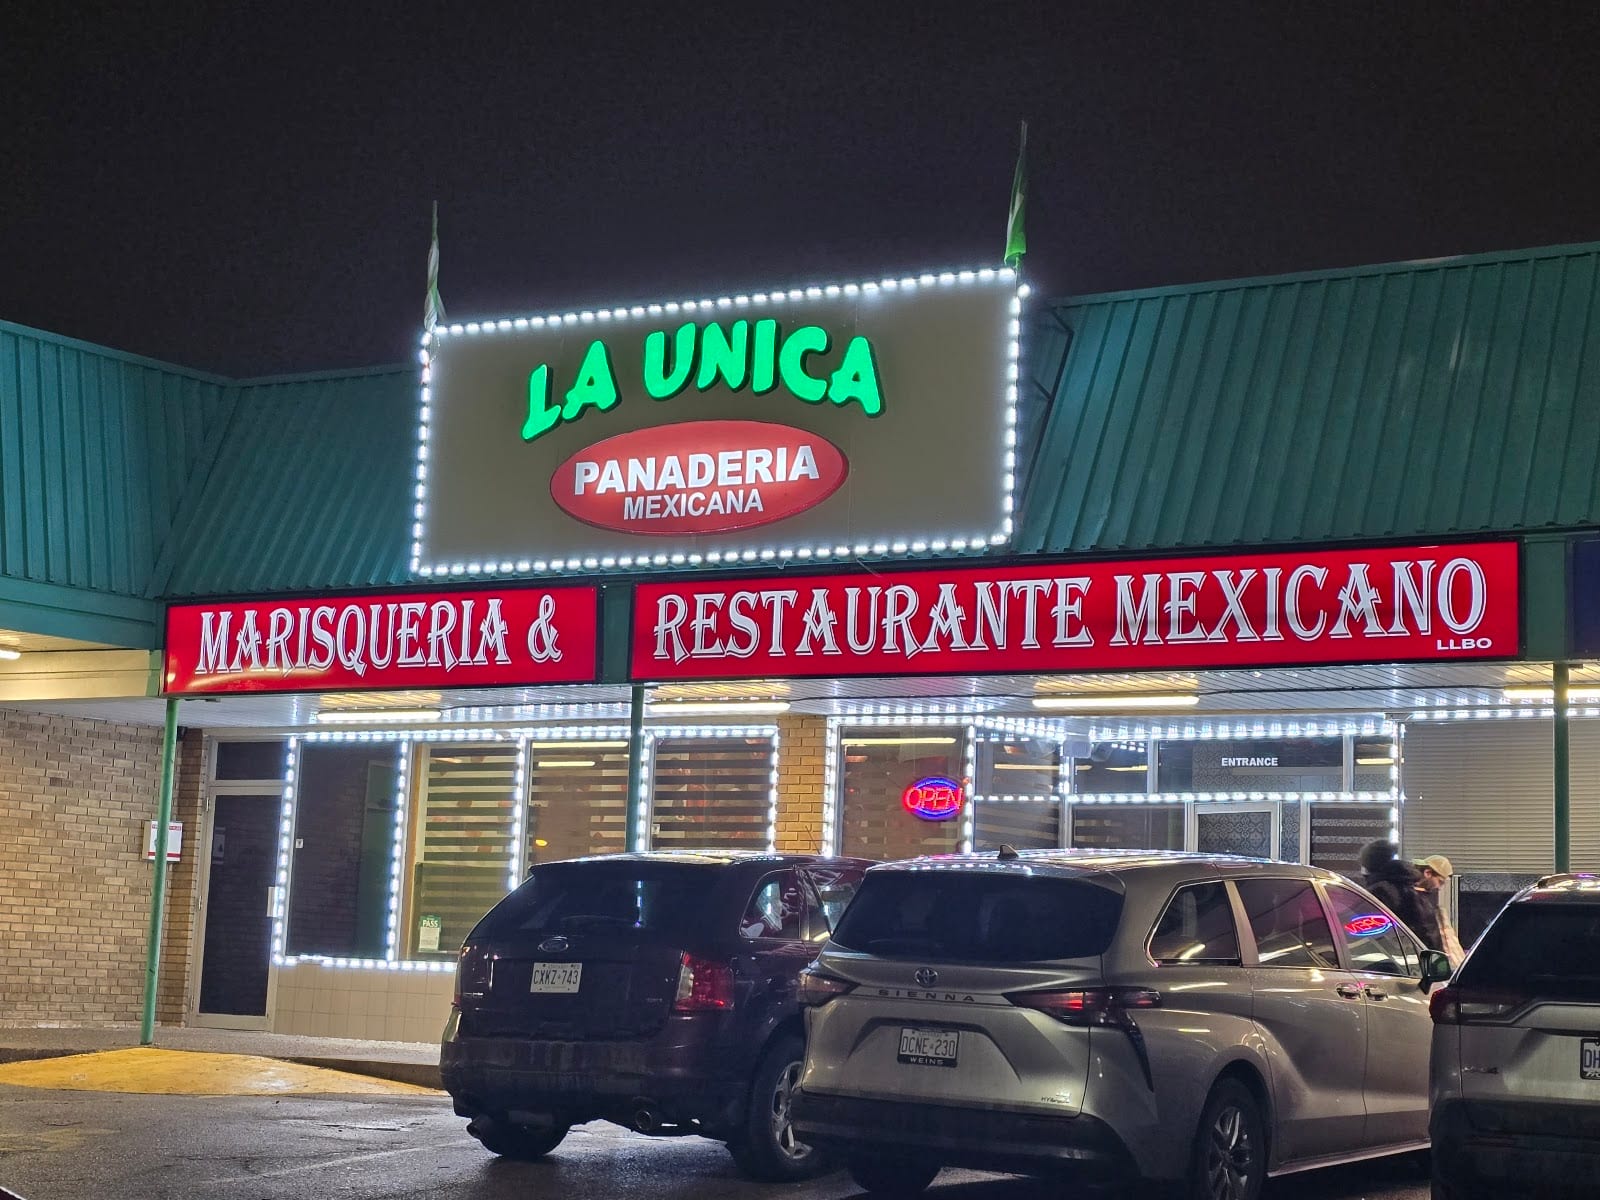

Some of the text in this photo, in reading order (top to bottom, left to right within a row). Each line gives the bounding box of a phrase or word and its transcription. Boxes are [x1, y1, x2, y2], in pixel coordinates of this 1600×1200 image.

[521, 319, 884, 442] LA UNICA
[574, 445, 820, 495] PANADERIA
[623, 488, 764, 520] MEXICANA
[653, 558, 1487, 665] RESTAURANTE MEXICANO
[195, 594, 563, 678] MARISQUERIA &
[1436, 637, 1493, 650] LLBO
[1221, 757, 1279, 767] ENTRANCE
[905, 787, 964, 810] OPEN
[422, 919, 439, 928] PASS
[878, 989, 975, 1002] SIENNA
[910, 1056, 945, 1065] WEINS
